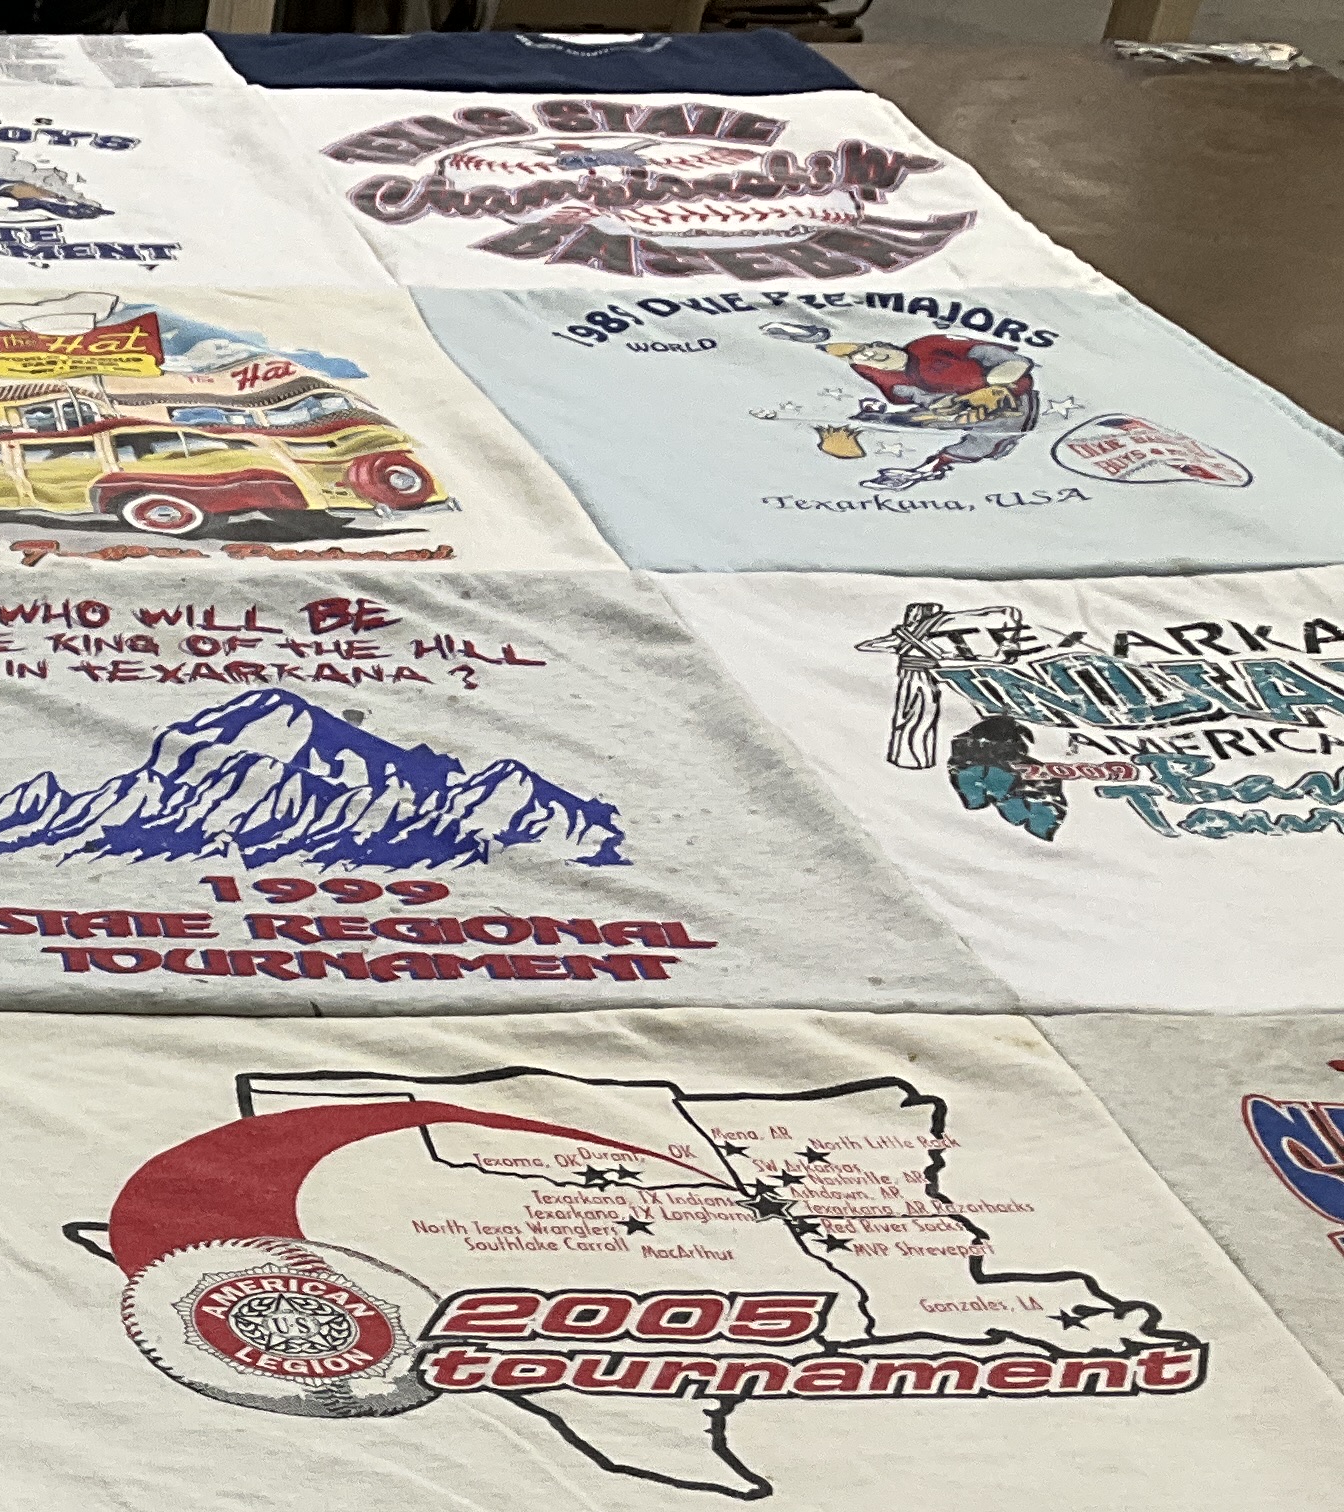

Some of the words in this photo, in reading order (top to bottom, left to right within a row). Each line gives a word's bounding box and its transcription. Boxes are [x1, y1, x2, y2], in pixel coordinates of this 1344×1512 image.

[532, 100, 790, 147] STATE
[43, 326, 149, 353] Hat
[626, 338, 717, 353] WORLD
[230, 361, 297, 391] Hat
[761, 491, 978, 516] Texarkana,
[985, 486, 1093, 508] USA
[138, 603, 285, 634] WILL
[303, 598, 402, 634] BE
[46, 633, 161, 656] KING
[176, 634, 263, 660] OF
[275, 638, 391, 663] THE
[412, 636, 548, 667] HILL
[4, 660, 49, 682] IN
[73, 660, 434, 685] TEXARKANA
[199, 874, 450, 906] 1999
[243, 912, 719, 950] REGIONAL
[39, 944, 685, 982] TOURNAMENT
[811, 1138, 861, 1150] North
[412, 1220, 468, 1235] North
[472, 1220, 523, 1235] Texas
[526, 1221, 619, 1238] Wranglers
[820, 1219, 856, 1233] Red
[863, 1219, 908, 1233] River
[914, 1218, 964, 1234] Socks
[464, 1237, 559, 1252] Southlake
[563, 1237, 629, 1252] Carroll
[201, 1275, 376, 1322] AMERICAN
[422, 1289, 839, 1344] 2005
[233, 1344, 376, 1377] LEGION
[420, 1340, 1208, 1396] tournament
